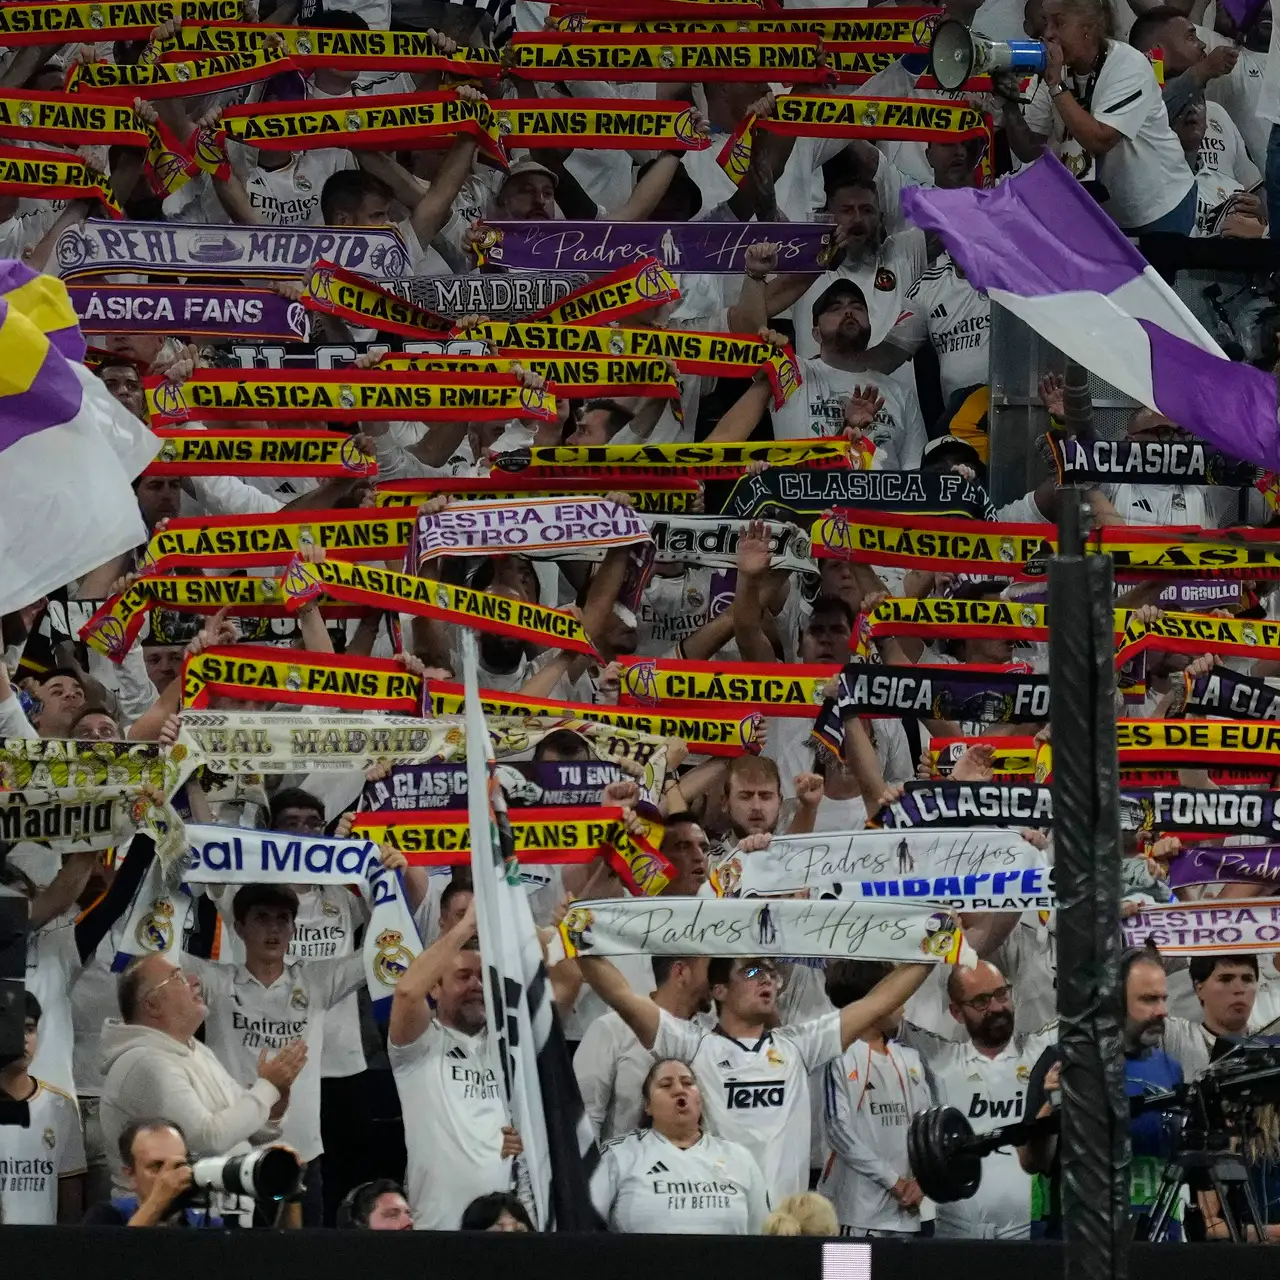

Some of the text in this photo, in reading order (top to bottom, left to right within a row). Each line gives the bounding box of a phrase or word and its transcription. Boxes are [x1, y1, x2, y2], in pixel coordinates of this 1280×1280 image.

[107, 0, 175, 26] FANS
[680, 45, 751, 69] FANS
[517, 111, 673, 136] FANS RMCF
[250, 192, 319, 216] Emirates
[99, 228, 370, 270] REAL MADRID
[183, 297, 264, 324] FANS
[359, 385, 432, 408] FANS
[439, 385, 518, 408] RMCF
[181, 439, 339, 463] FANS RMCF
[1062, 438, 1205, 477] LA CLASICA
[779, 472, 925, 503] CLASICA
[319, 520, 390, 547] FANS
[1163, 725, 1211, 748] DE
[1154, 791, 1262, 827] FONDO
[784, 838, 890, 883] Padres
[628, 901, 916, 949] Padres Hijos
[231, 1011, 308, 1038] Emirates
[10, 1176, 46, 1192] BETTER
[653, 1178, 738, 1200] Emirates
[668, 1194, 731, 1210] FLY BETTER
